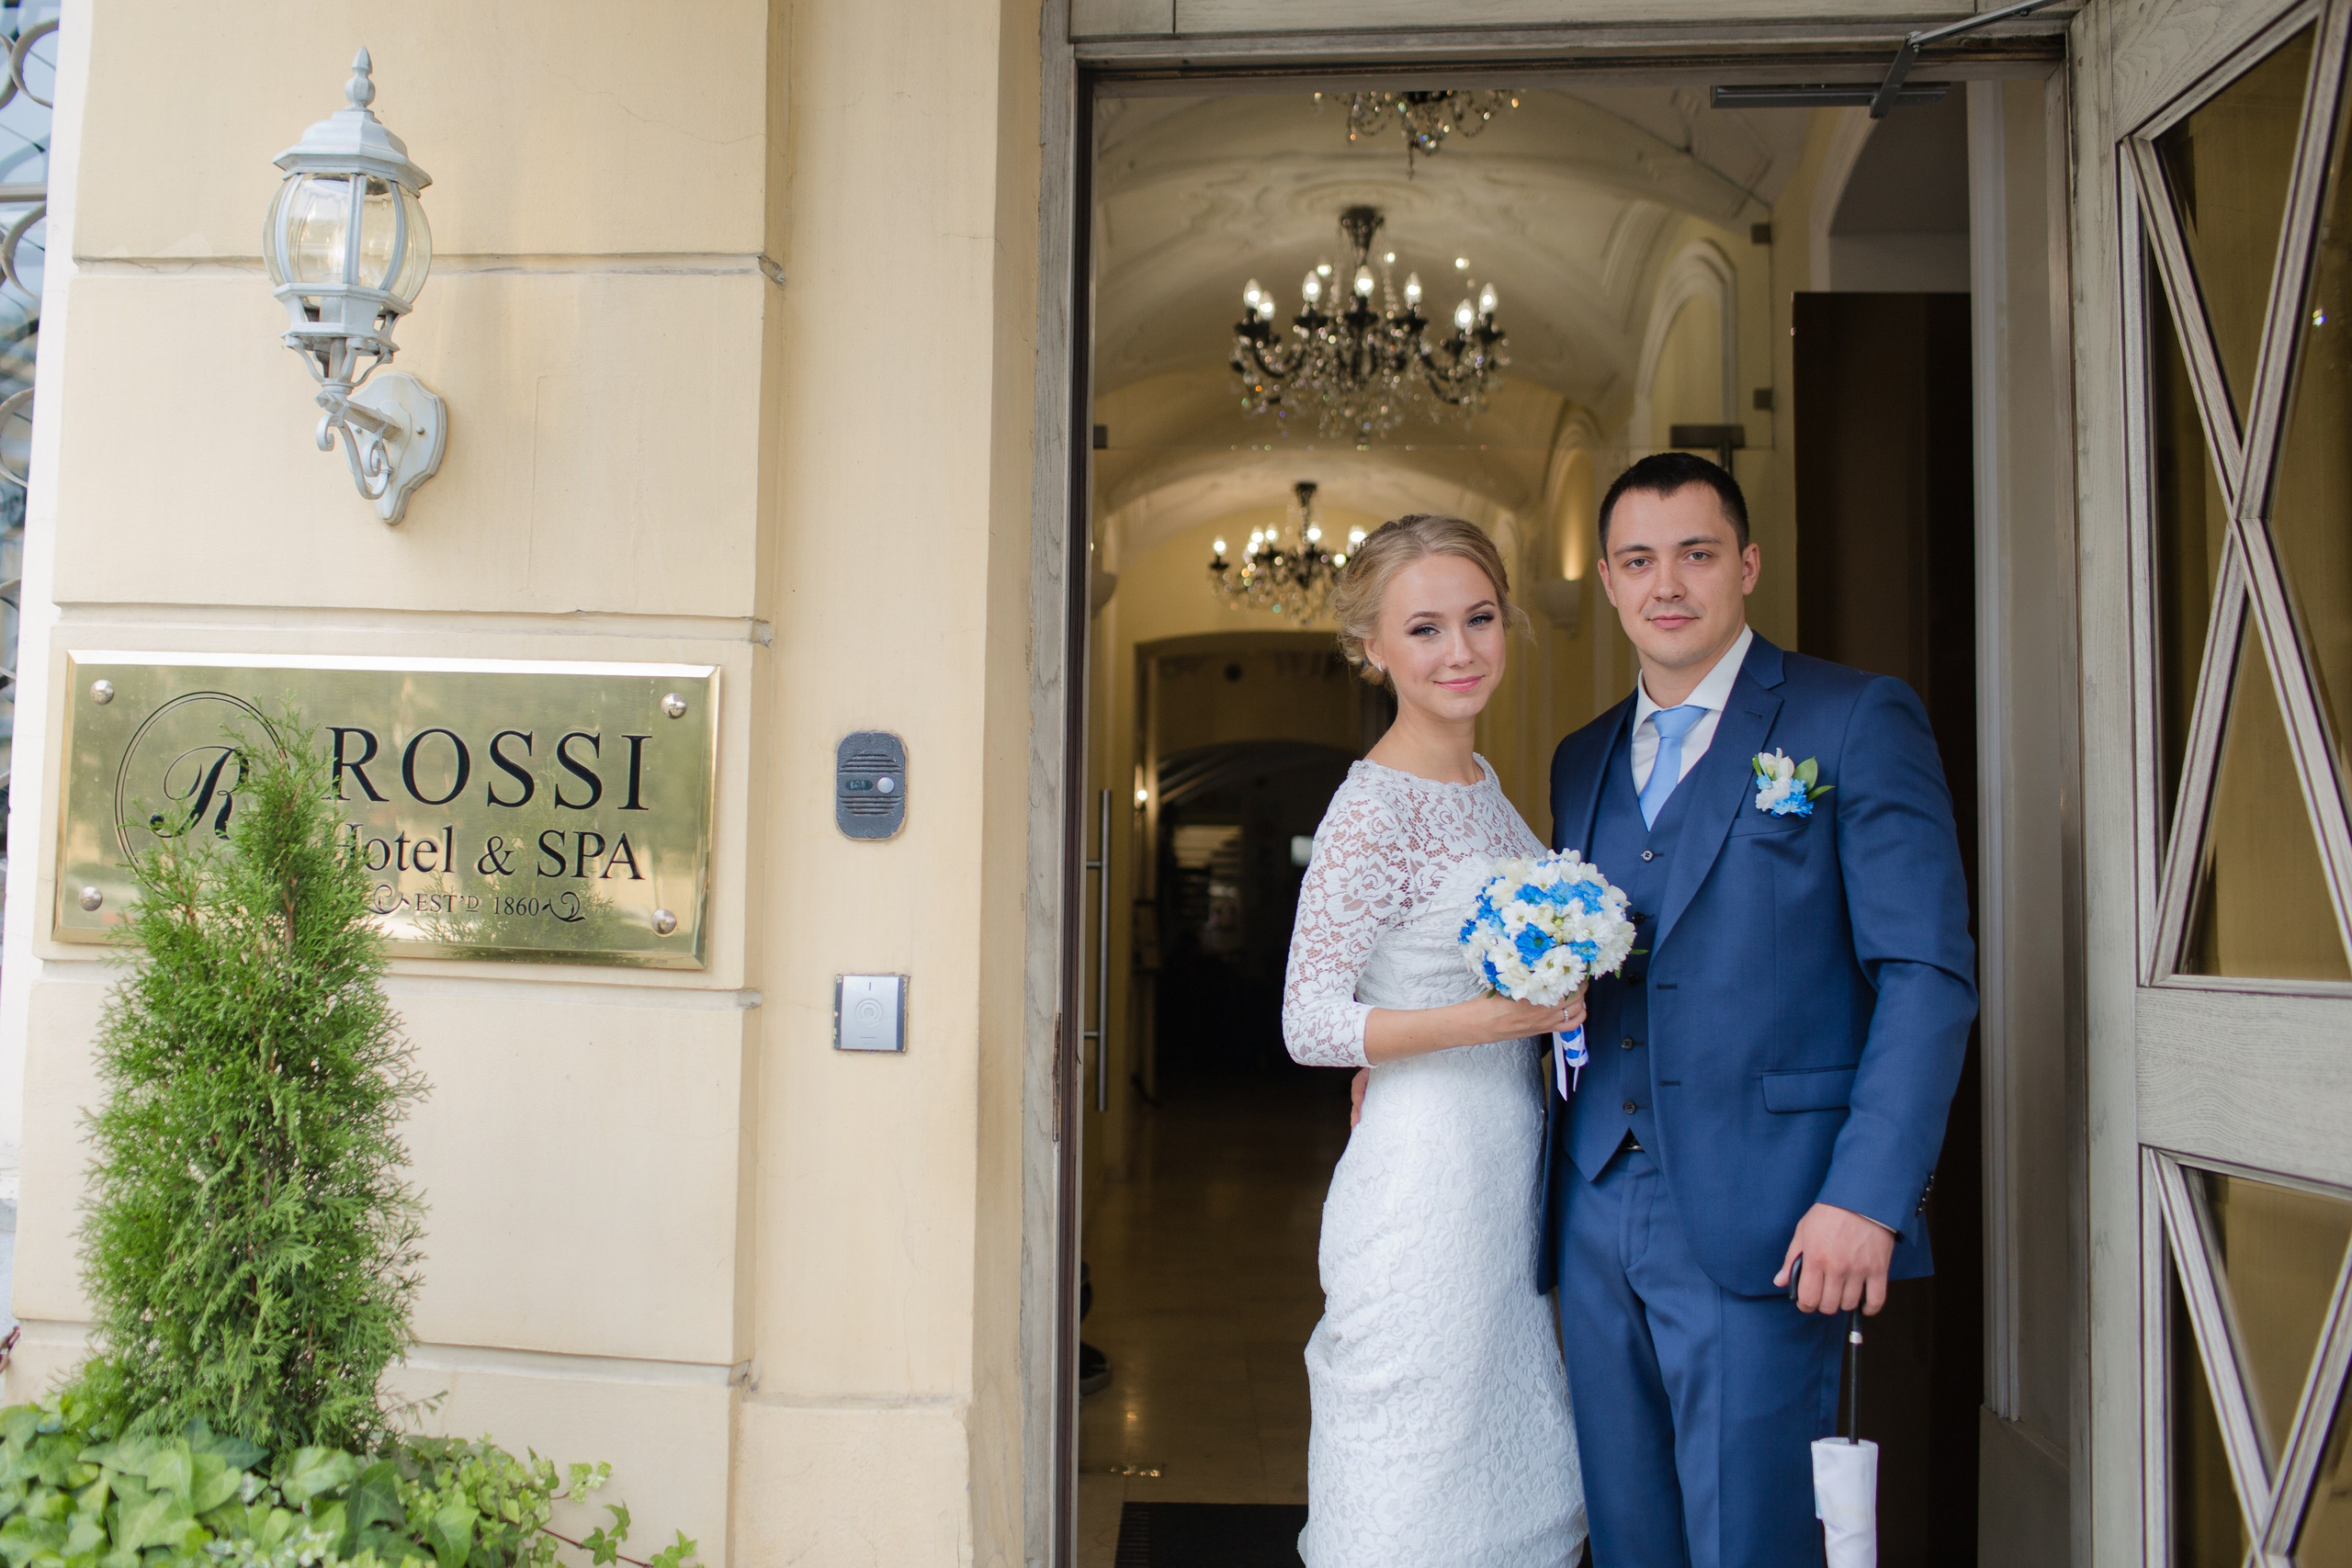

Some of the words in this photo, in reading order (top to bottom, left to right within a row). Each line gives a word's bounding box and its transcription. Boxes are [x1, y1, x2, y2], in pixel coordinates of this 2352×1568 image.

[322, 727, 653, 811] ROSSI
[477, 835, 516, 876] &
[537, 829, 646, 881] SPA
[493, 896, 540, 917] 1860
